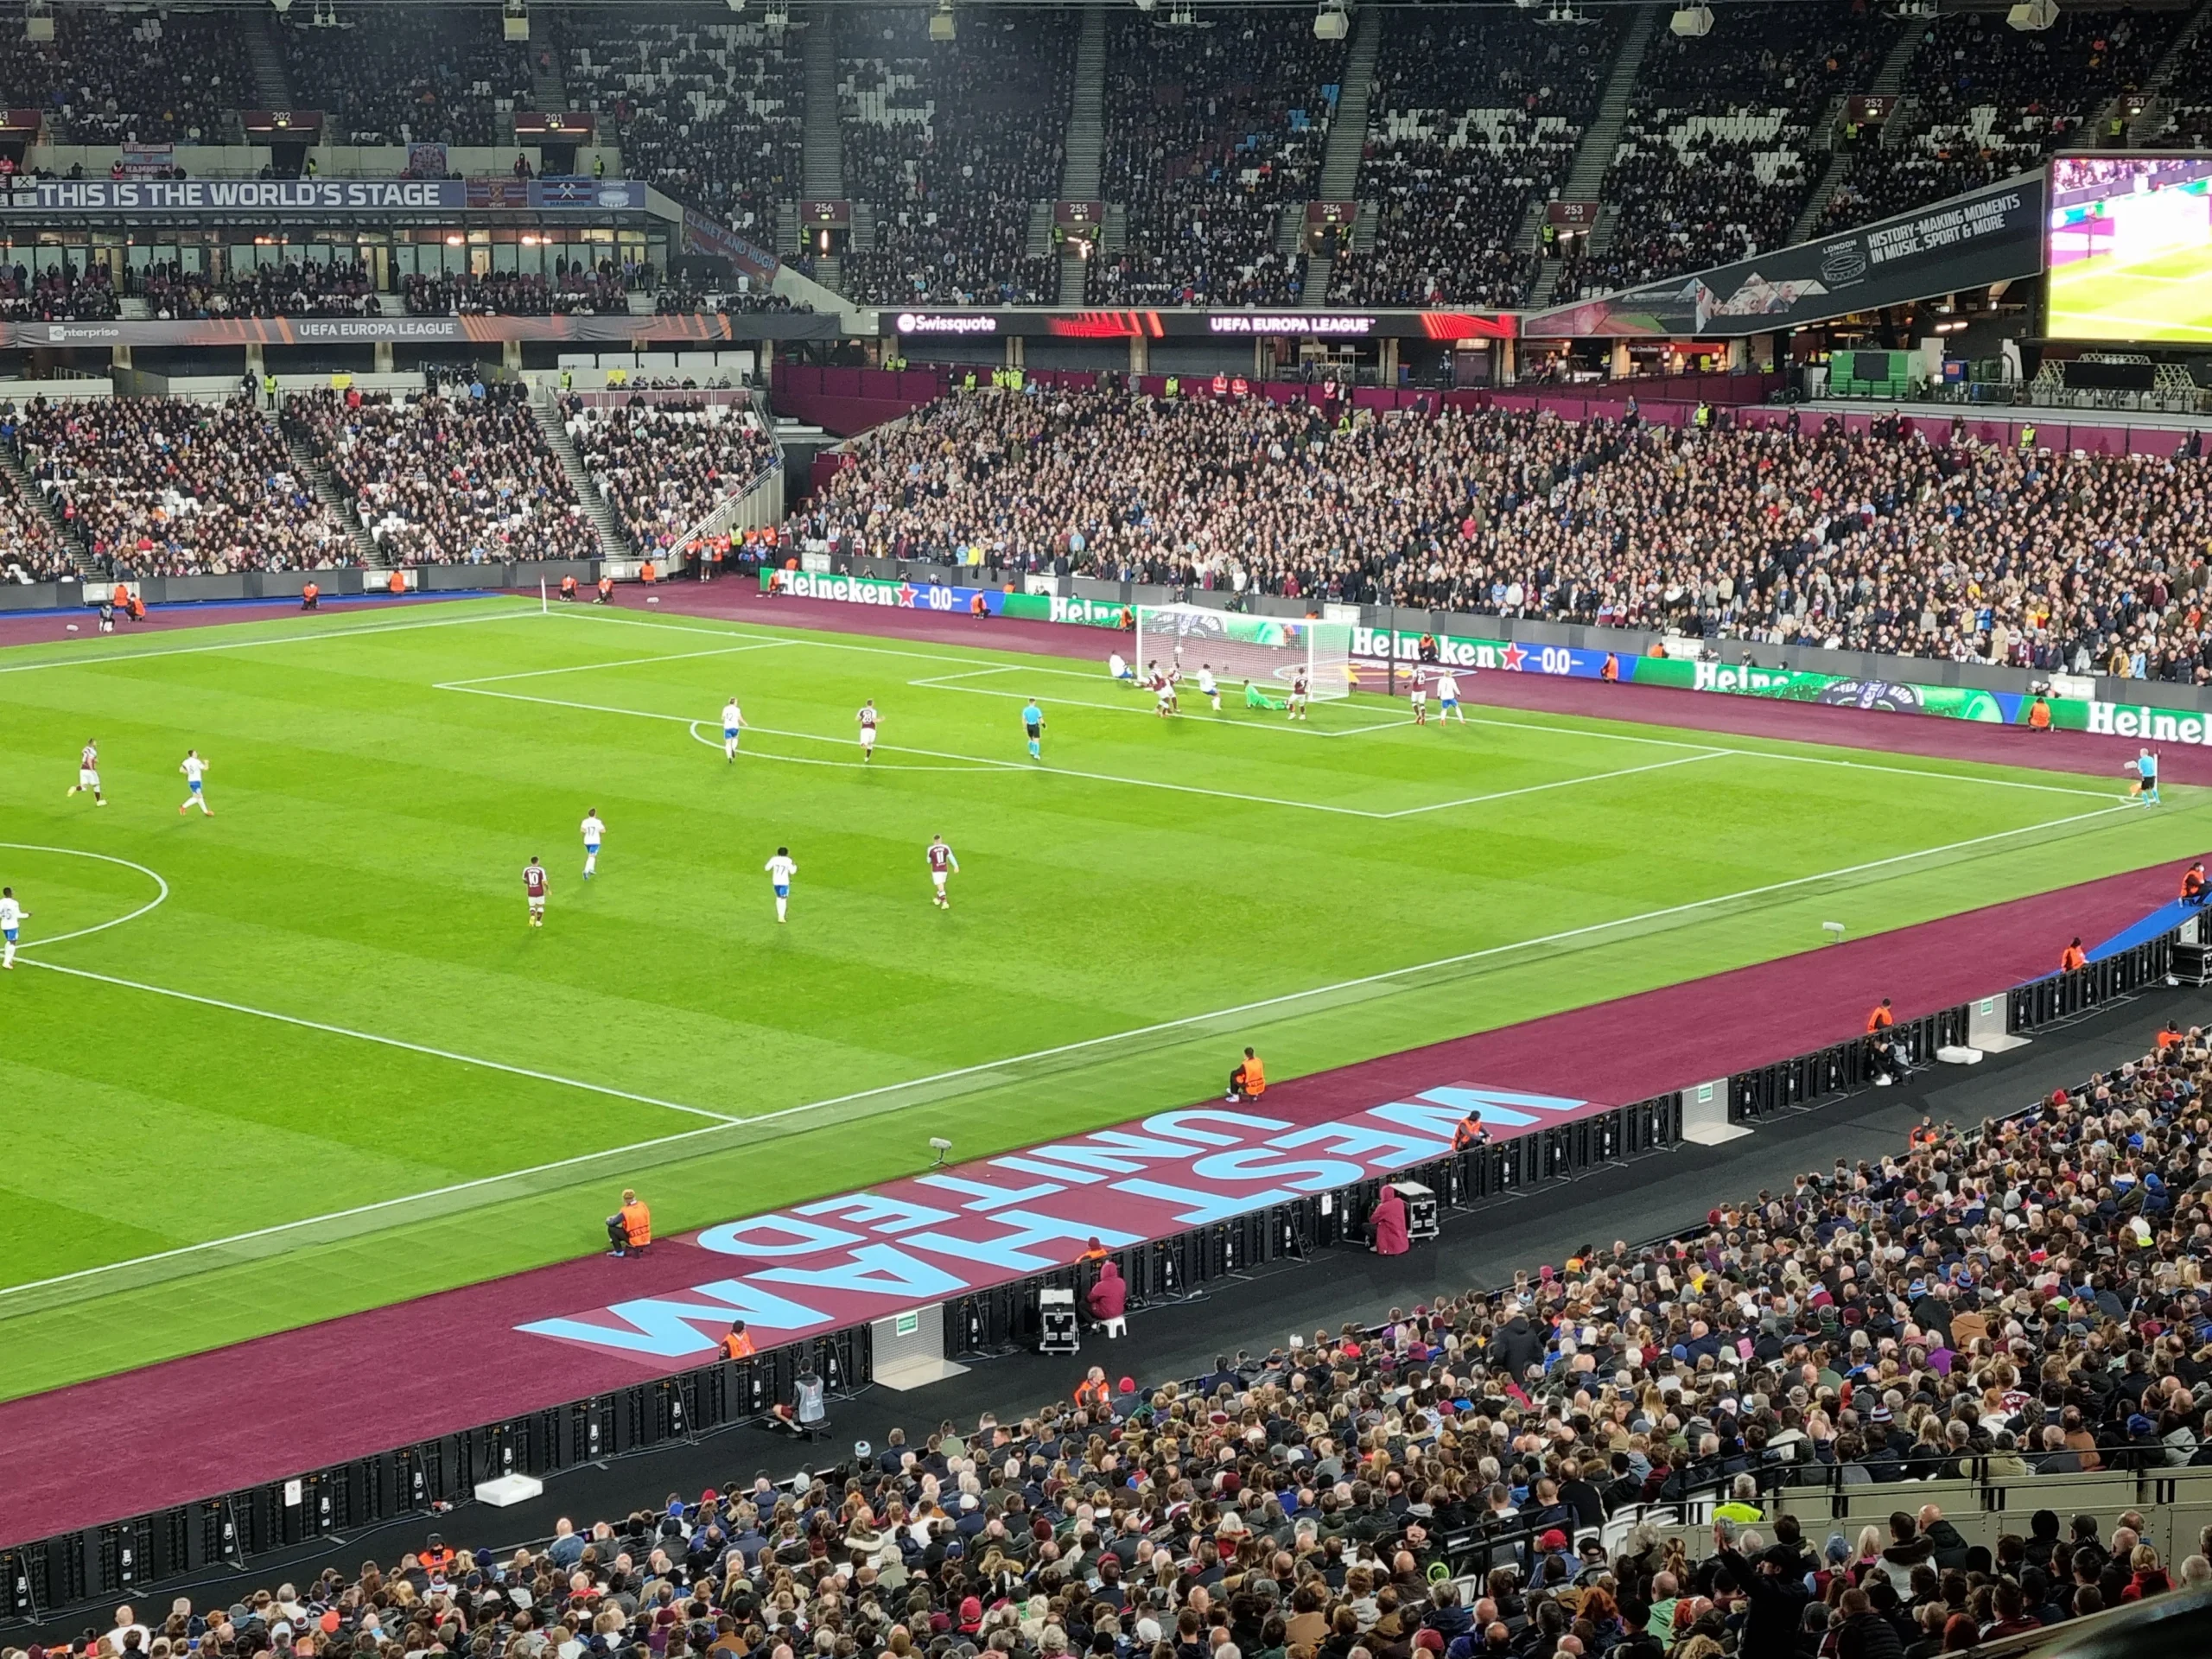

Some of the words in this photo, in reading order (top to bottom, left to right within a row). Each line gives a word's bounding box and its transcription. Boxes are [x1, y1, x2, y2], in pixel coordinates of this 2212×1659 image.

[1864, 98, 1884, 108] 252
[2126, 97, 2145, 107] 251
[272, 111, 292, 122] 202
[544, 113, 563, 124] 201
[38, 183, 106, 207] THIS
[113, 183, 139, 207] IS
[144, 183, 203, 207] THE
[209, 182, 342, 207] WORLD'S
[347, 182, 441, 207] STAGE
[814, 203, 834, 213] 256
[1069, 203, 1089, 214] 255
[1322, 203, 1342, 214] 254
[1564, 204, 1584, 216] 253
[1867, 209, 1964, 249] HISTORY-MAKING
[1963, 193, 2021, 218] MOMENTS
[685, 210, 724, 240] CLARET
[724, 237, 747, 255] AND
[747, 246, 777, 270] HUGH
[1870, 248, 1885, 264] IN
[1884, 239, 1925, 260] MUSIC,
[1923, 226, 1961, 250] SPORT
[1961, 226, 1973, 238] &
[1972, 213, 2006, 236] MORE
[1822, 238, 1858, 255] LONDON
[299, 323, 338, 336] UEFA
[340, 322, 397, 336] EUROPA
[916, 315, 996, 334] Swissquote
[1211, 317, 1251, 332] UEFA
[1252, 317, 1310, 332] EUROPA
[779, 569, 894, 607] Heineken
[1351, 626, 1497, 669] Heinken
[588, 826, 596, 837] 17
[774, 864, 786, 875] 77
[528, 872, 539, 886] 10
[1107, 1086, 1589, 1225] WEST
[696, 1109, 1295, 1257] UNITED
[512, 1210, 1150, 1357] HAM
